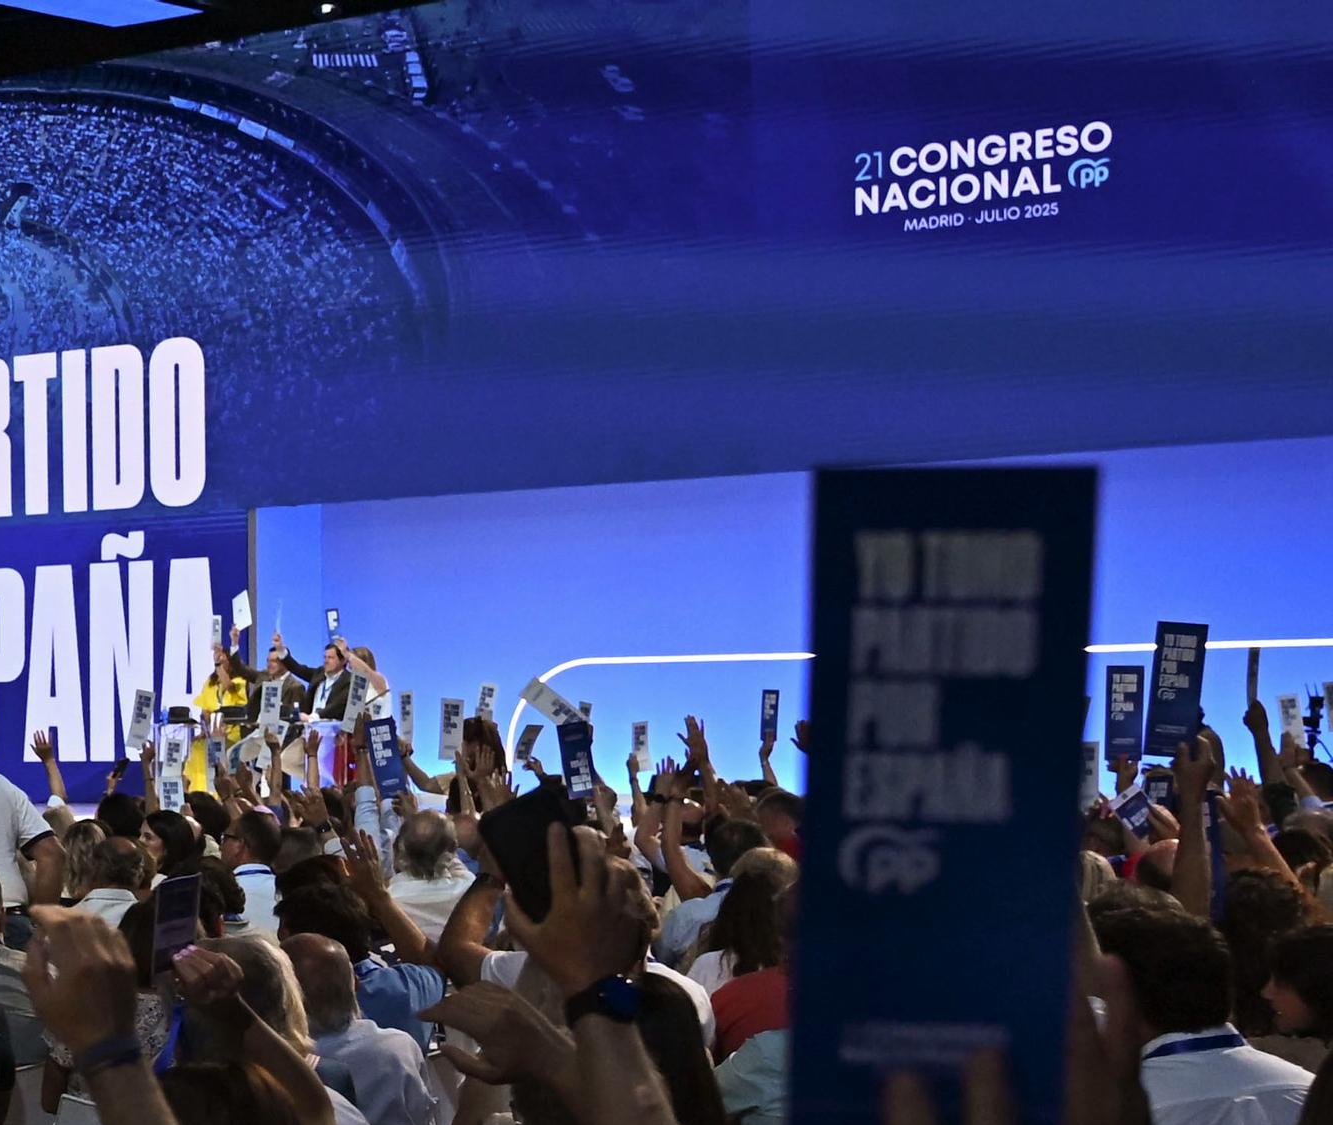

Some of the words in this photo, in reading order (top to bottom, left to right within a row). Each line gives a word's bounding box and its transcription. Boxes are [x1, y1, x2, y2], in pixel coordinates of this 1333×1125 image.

[854, 151, 884, 182] 21
[889, 121, 1113, 177] CONGRESO
[854, 163, 1062, 216] NACIONAL
[903, 212, 965, 232] MADRID
[974, 206, 1021, 224] JULIO
[1024, 202, 1059, 219] 2025
